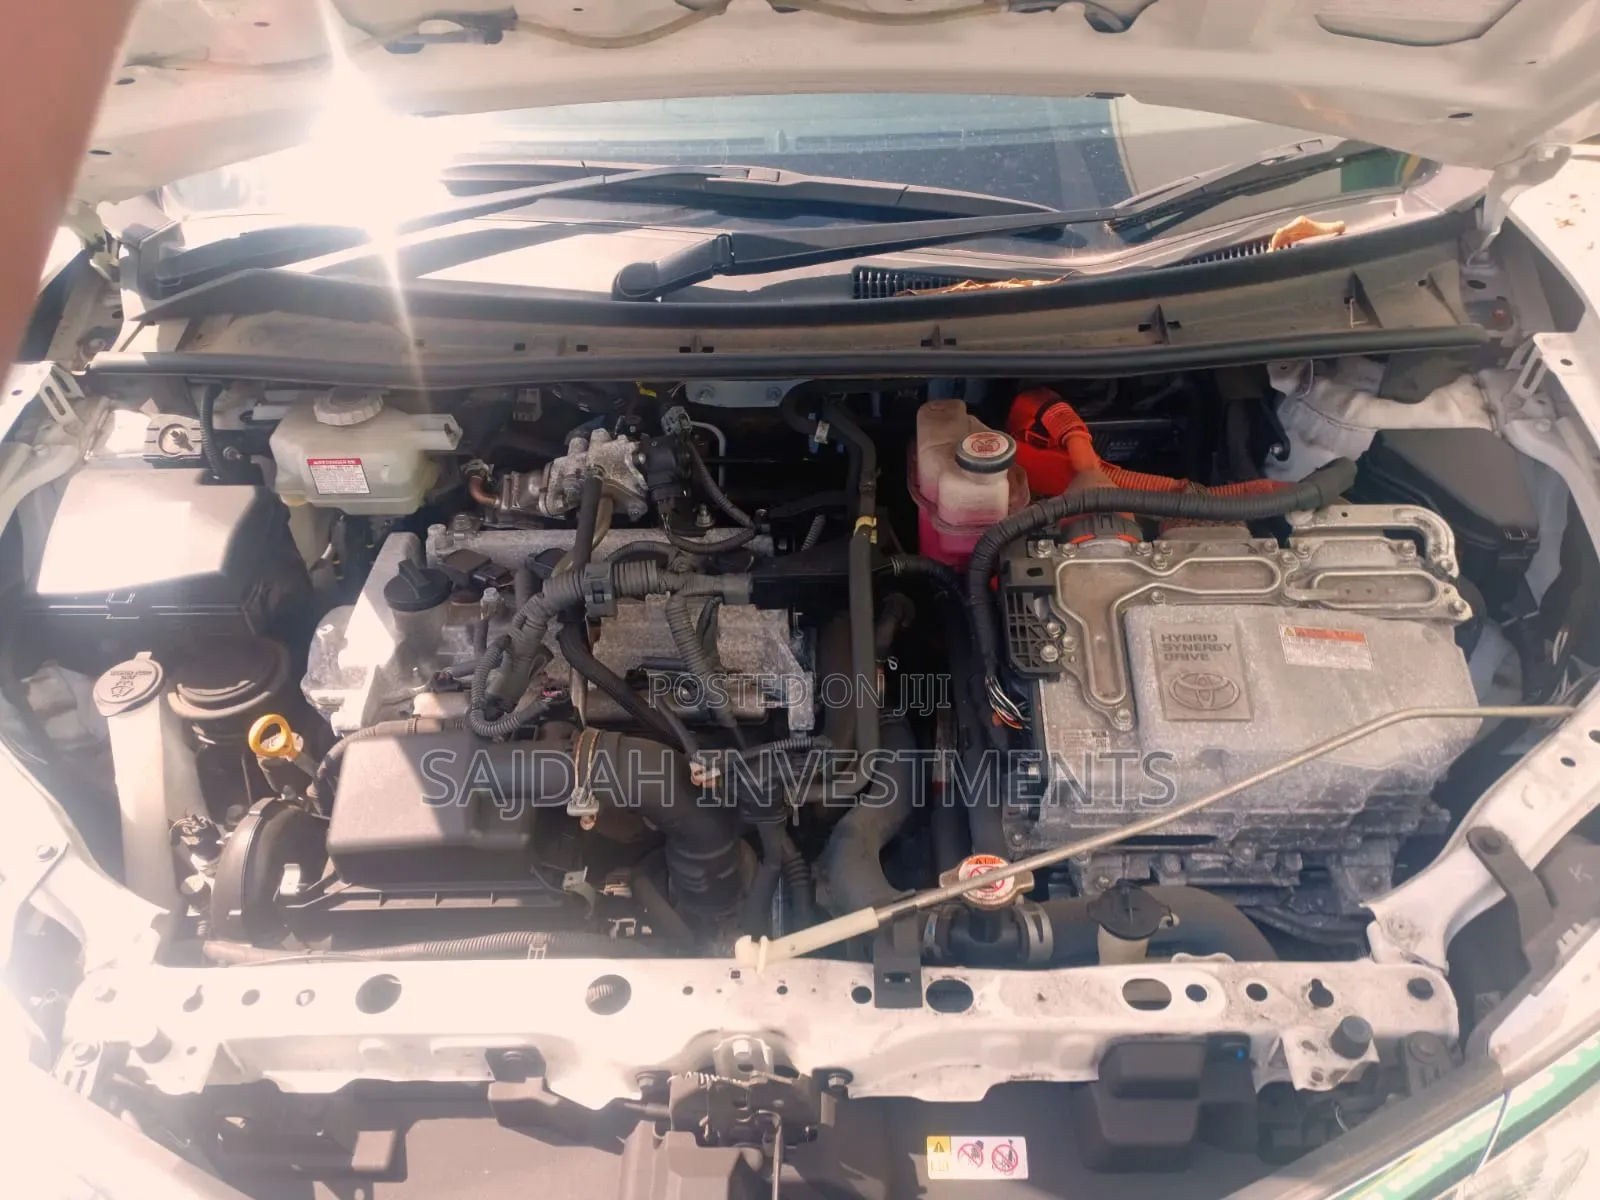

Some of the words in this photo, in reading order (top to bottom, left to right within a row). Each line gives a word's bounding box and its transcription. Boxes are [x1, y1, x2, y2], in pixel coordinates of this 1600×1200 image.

[1161, 633, 1218, 642] HYBRID
[1161, 643, 1232, 654] SYNERGY
[1164, 653, 1210, 661] DRIVE
